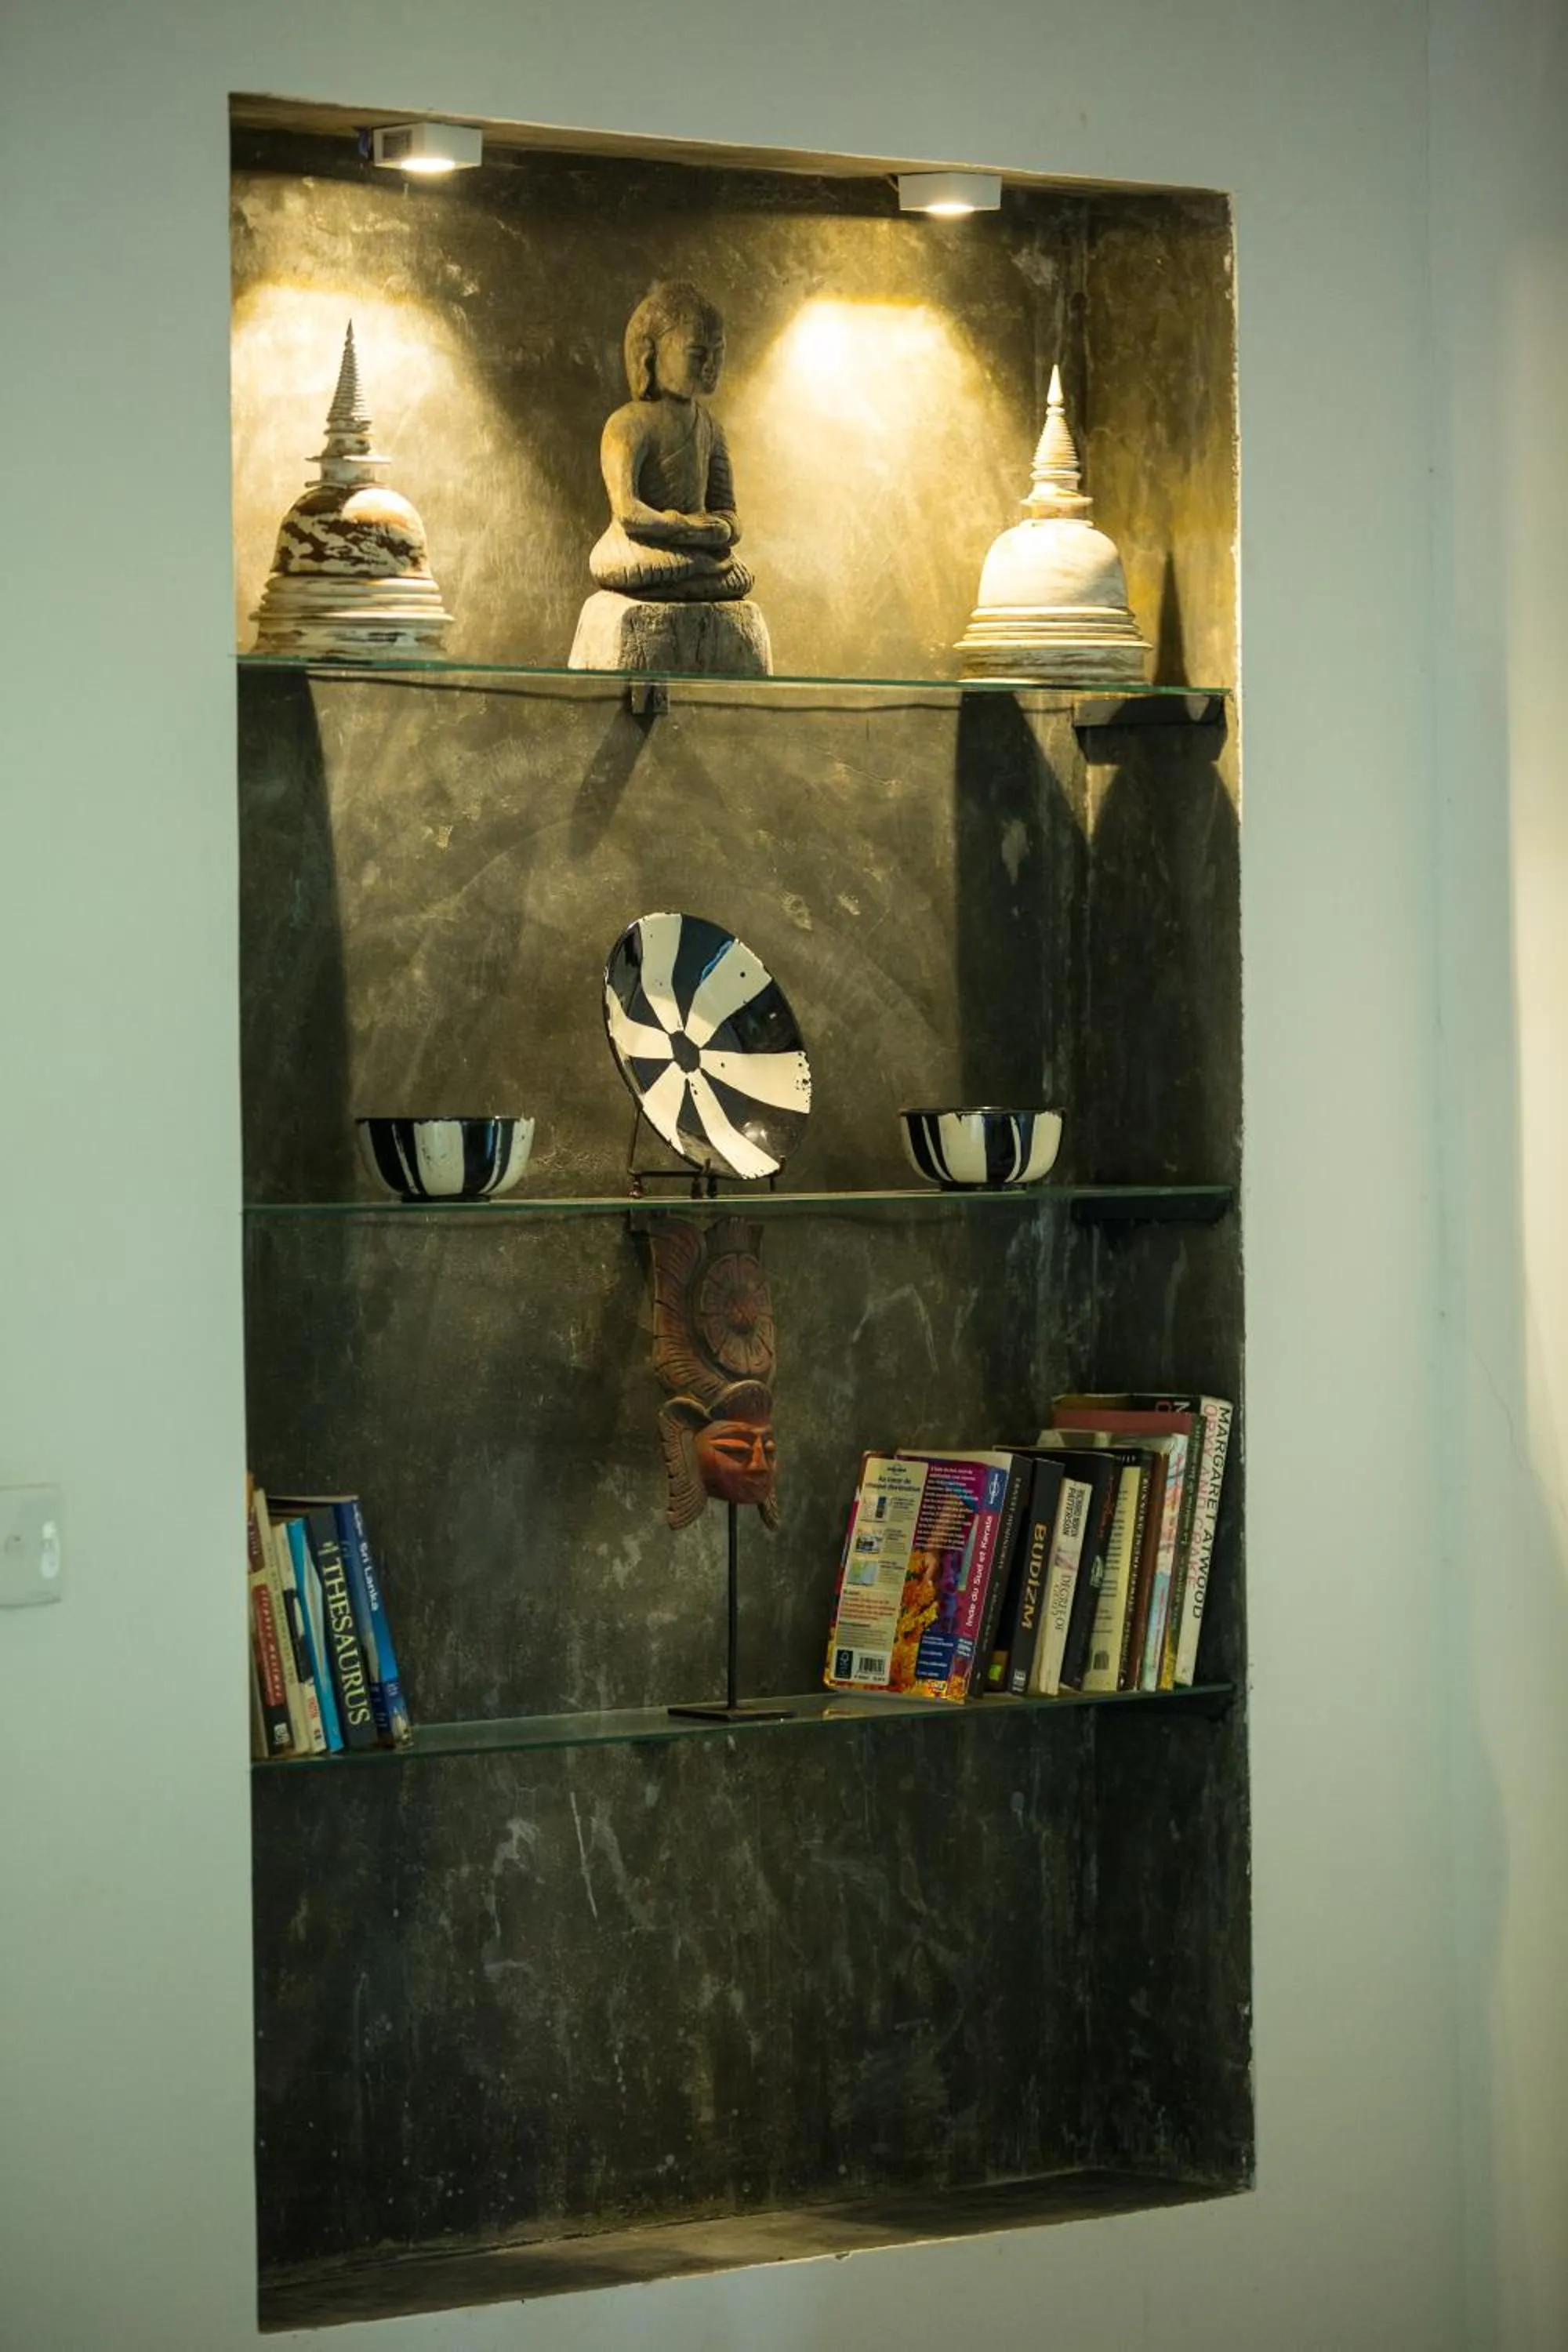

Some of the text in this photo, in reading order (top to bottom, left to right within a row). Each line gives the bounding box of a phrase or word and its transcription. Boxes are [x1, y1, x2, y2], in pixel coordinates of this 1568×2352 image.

[1192, 1406, 1231, 1620] MARGARET ATWOOD
[1196, 1467, 1210, 1510] AND
[359, 1541, 379, 1612] Sri Lanka
[966, 1515, 993, 1628] Inde du Sud et Kerala
[1022, 1522, 1047, 1631] BUDIZM
[1187, 1517, 1203, 1590] CRAKE
[321, 1556, 371, 1726] THESAURUS
